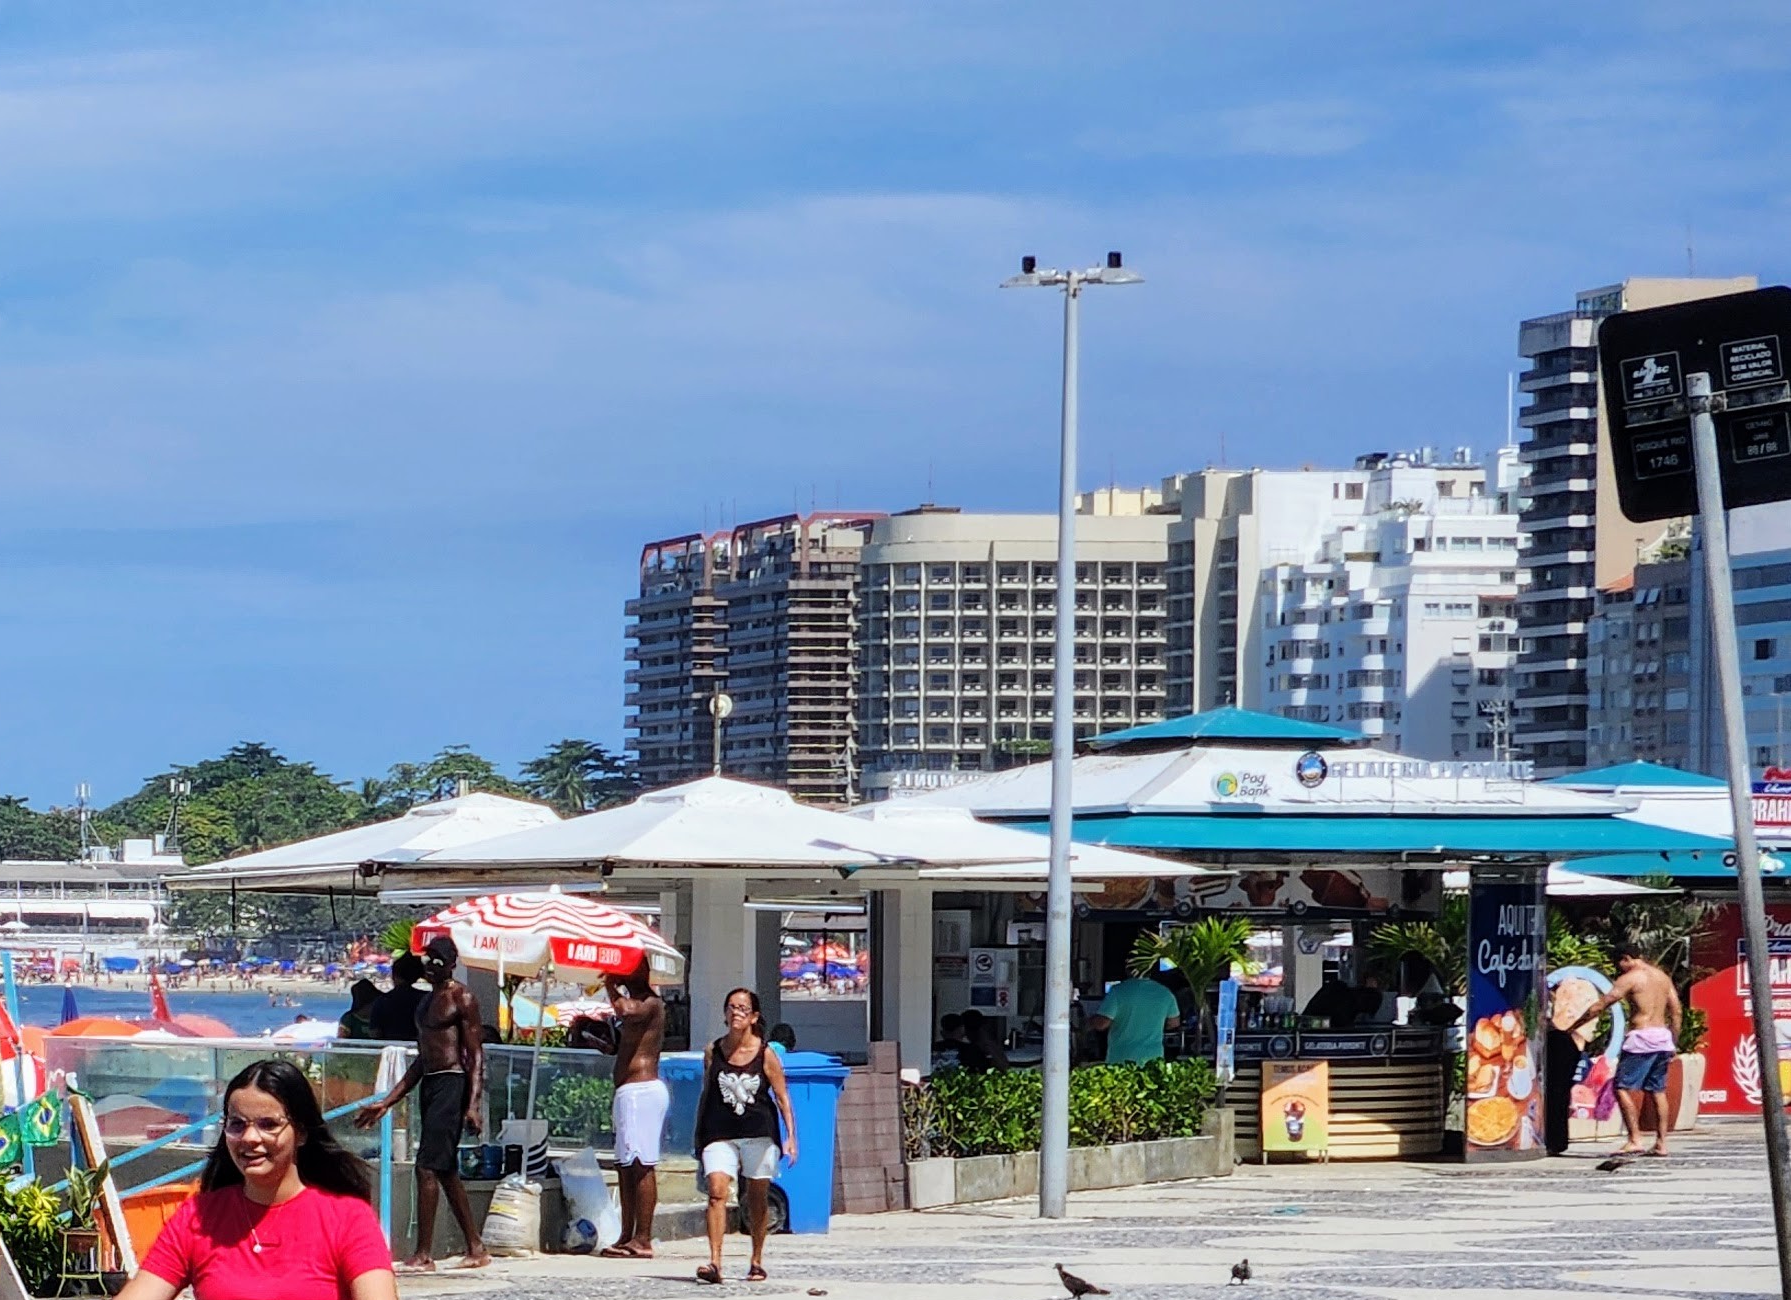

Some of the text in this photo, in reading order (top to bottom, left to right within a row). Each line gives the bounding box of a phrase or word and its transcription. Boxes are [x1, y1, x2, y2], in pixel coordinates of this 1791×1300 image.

[1731, 342, 1768, 354] MATERIAL
[1729, 350, 1772, 363] RECICLADO
[1731, 358, 1773, 372] SEM VALOR
[1731, 368, 1775, 381] COMERCIAL
[568, 942, 622, 966] I AM RIO
[1477, 938, 1519, 989] Café
